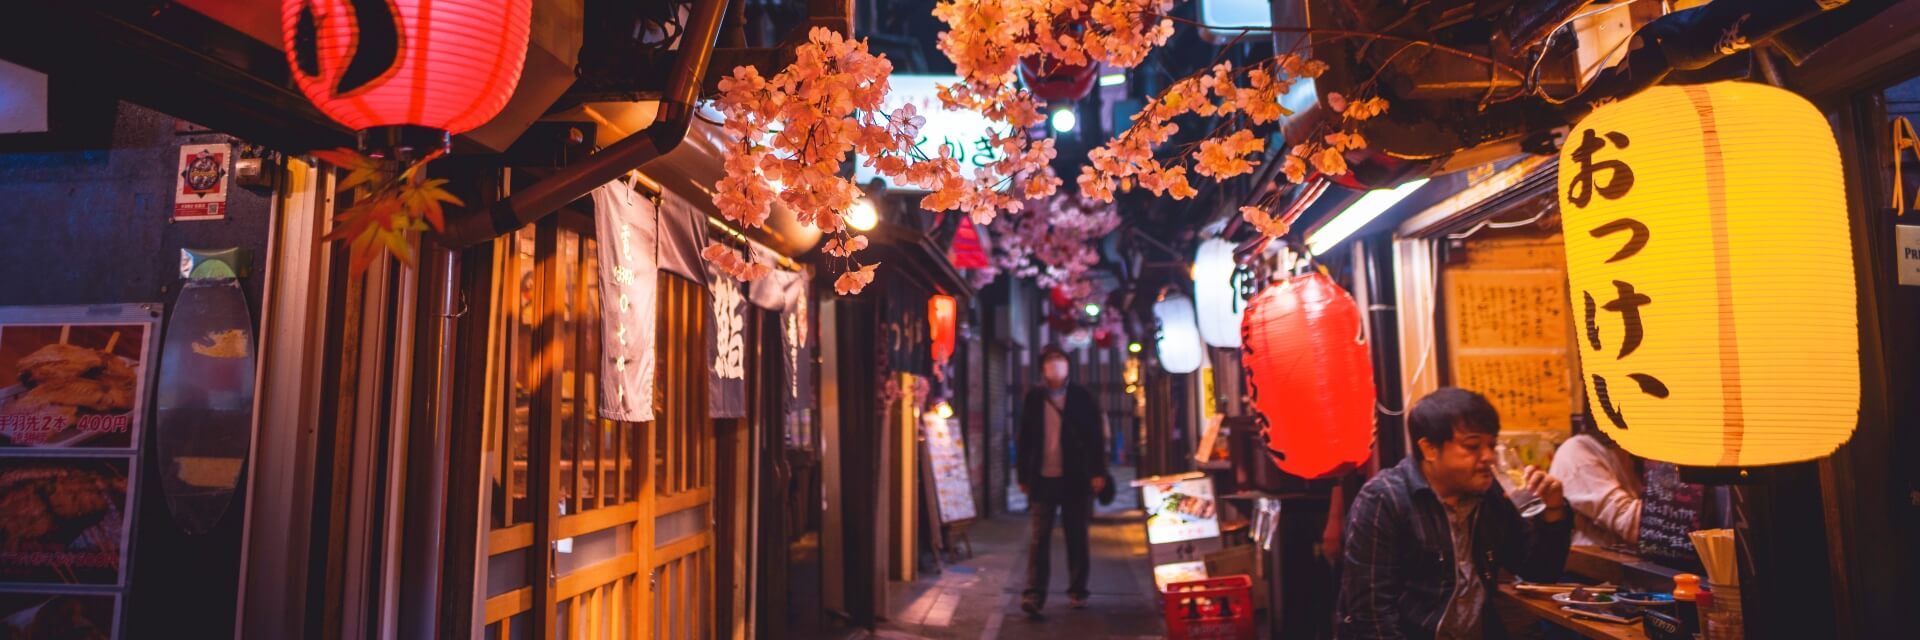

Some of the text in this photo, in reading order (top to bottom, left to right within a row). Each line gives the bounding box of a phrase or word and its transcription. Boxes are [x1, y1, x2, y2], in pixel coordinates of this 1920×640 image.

[1904, 247, 1920, 260] PR
[0, 415, 129, 433] 手羽先2本 400円
